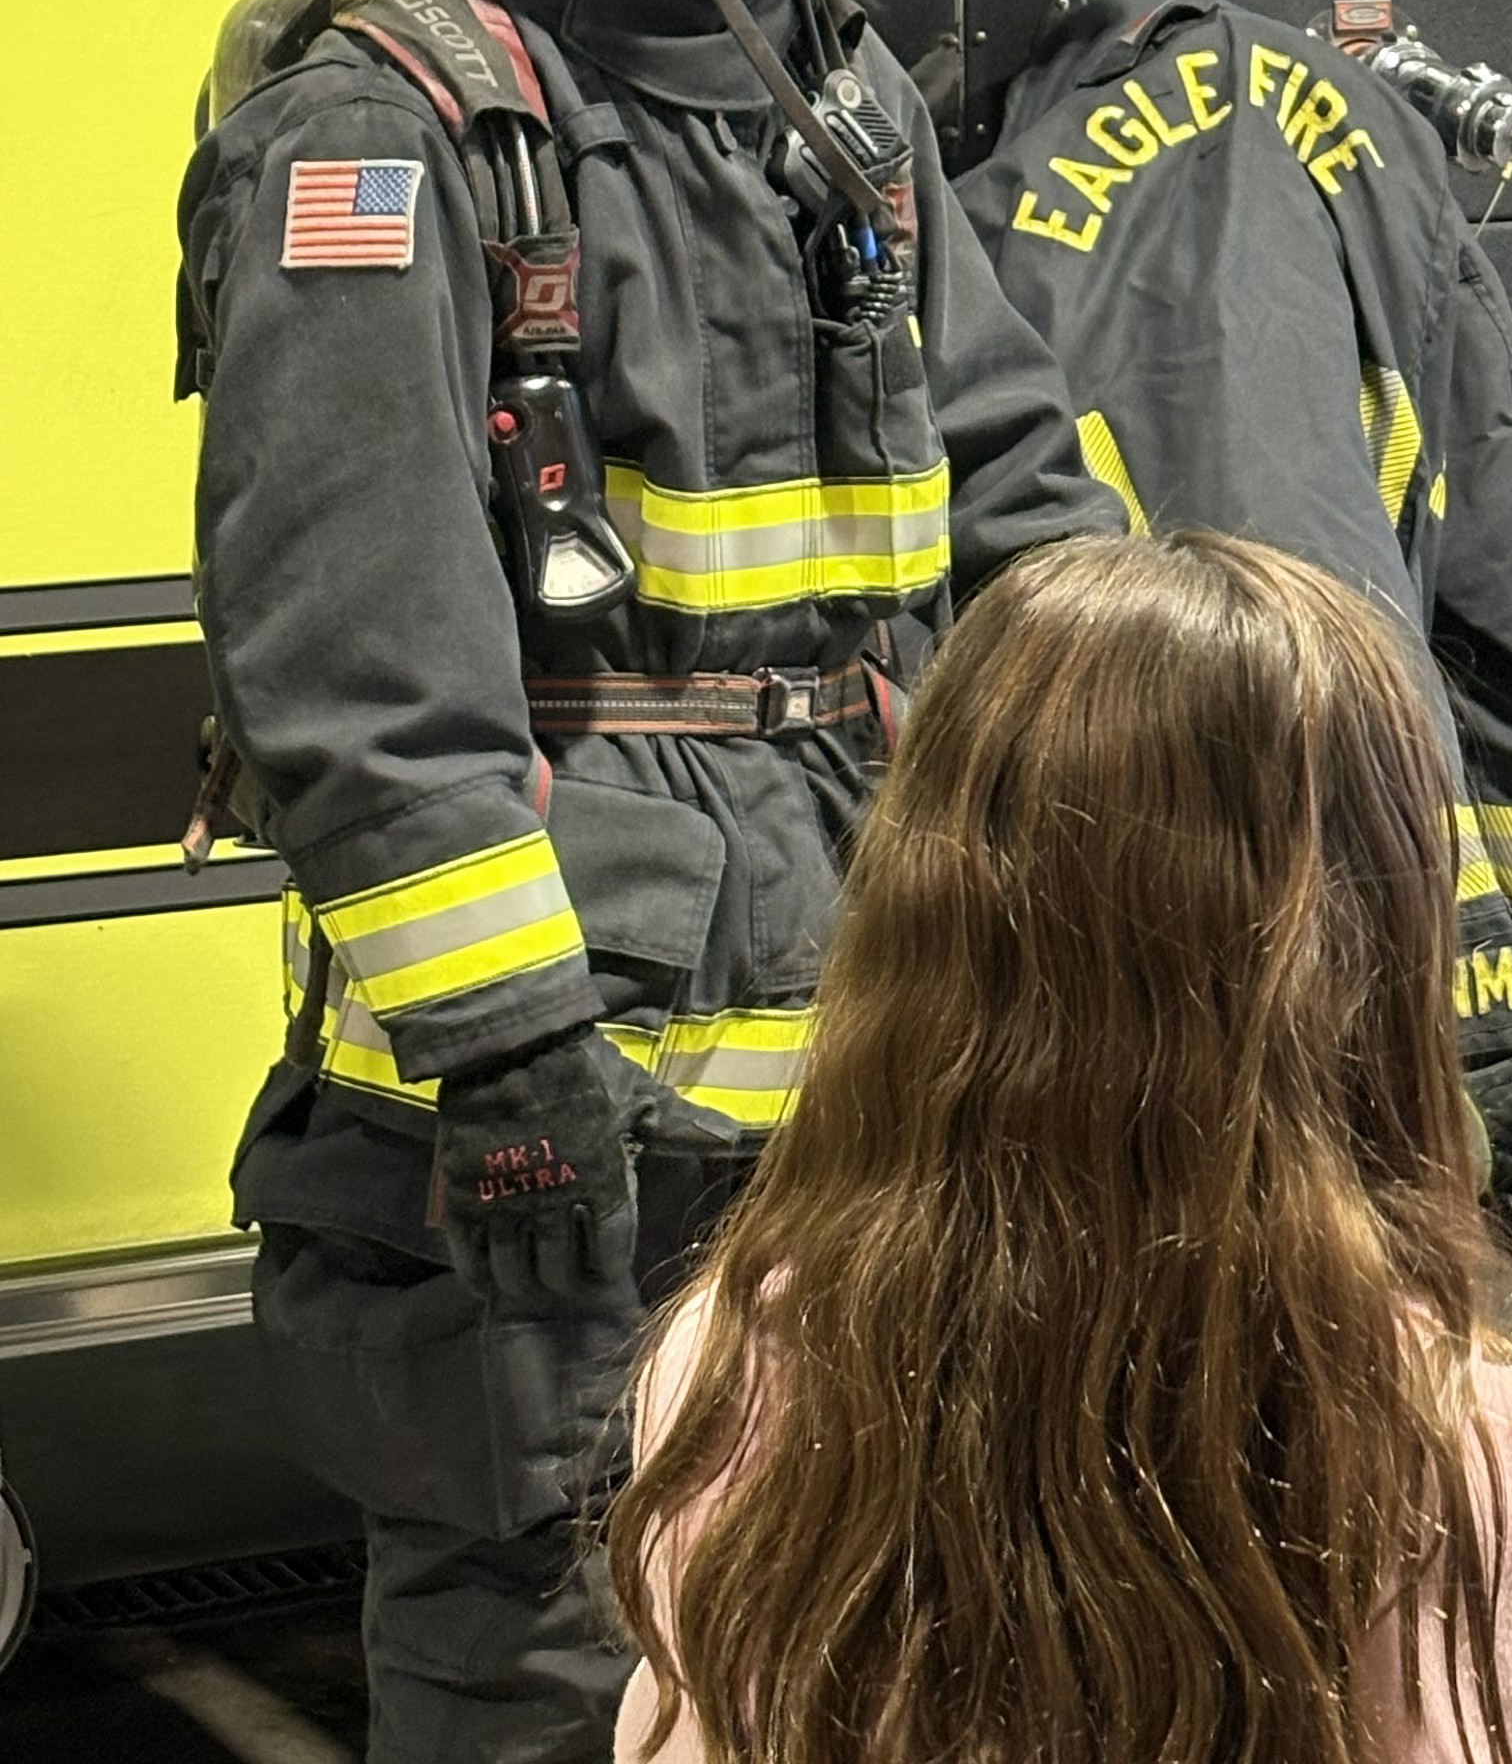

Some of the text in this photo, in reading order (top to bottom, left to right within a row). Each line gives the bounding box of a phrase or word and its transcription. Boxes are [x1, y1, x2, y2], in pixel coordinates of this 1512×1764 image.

[414, 1, 498, 88] SCOTT
[1012, 43, 1385, 252] EAGLE FIRE
[478, 1162, 577, 1201] ULTRA
[484, 1138, 554, 1173] MK-1
